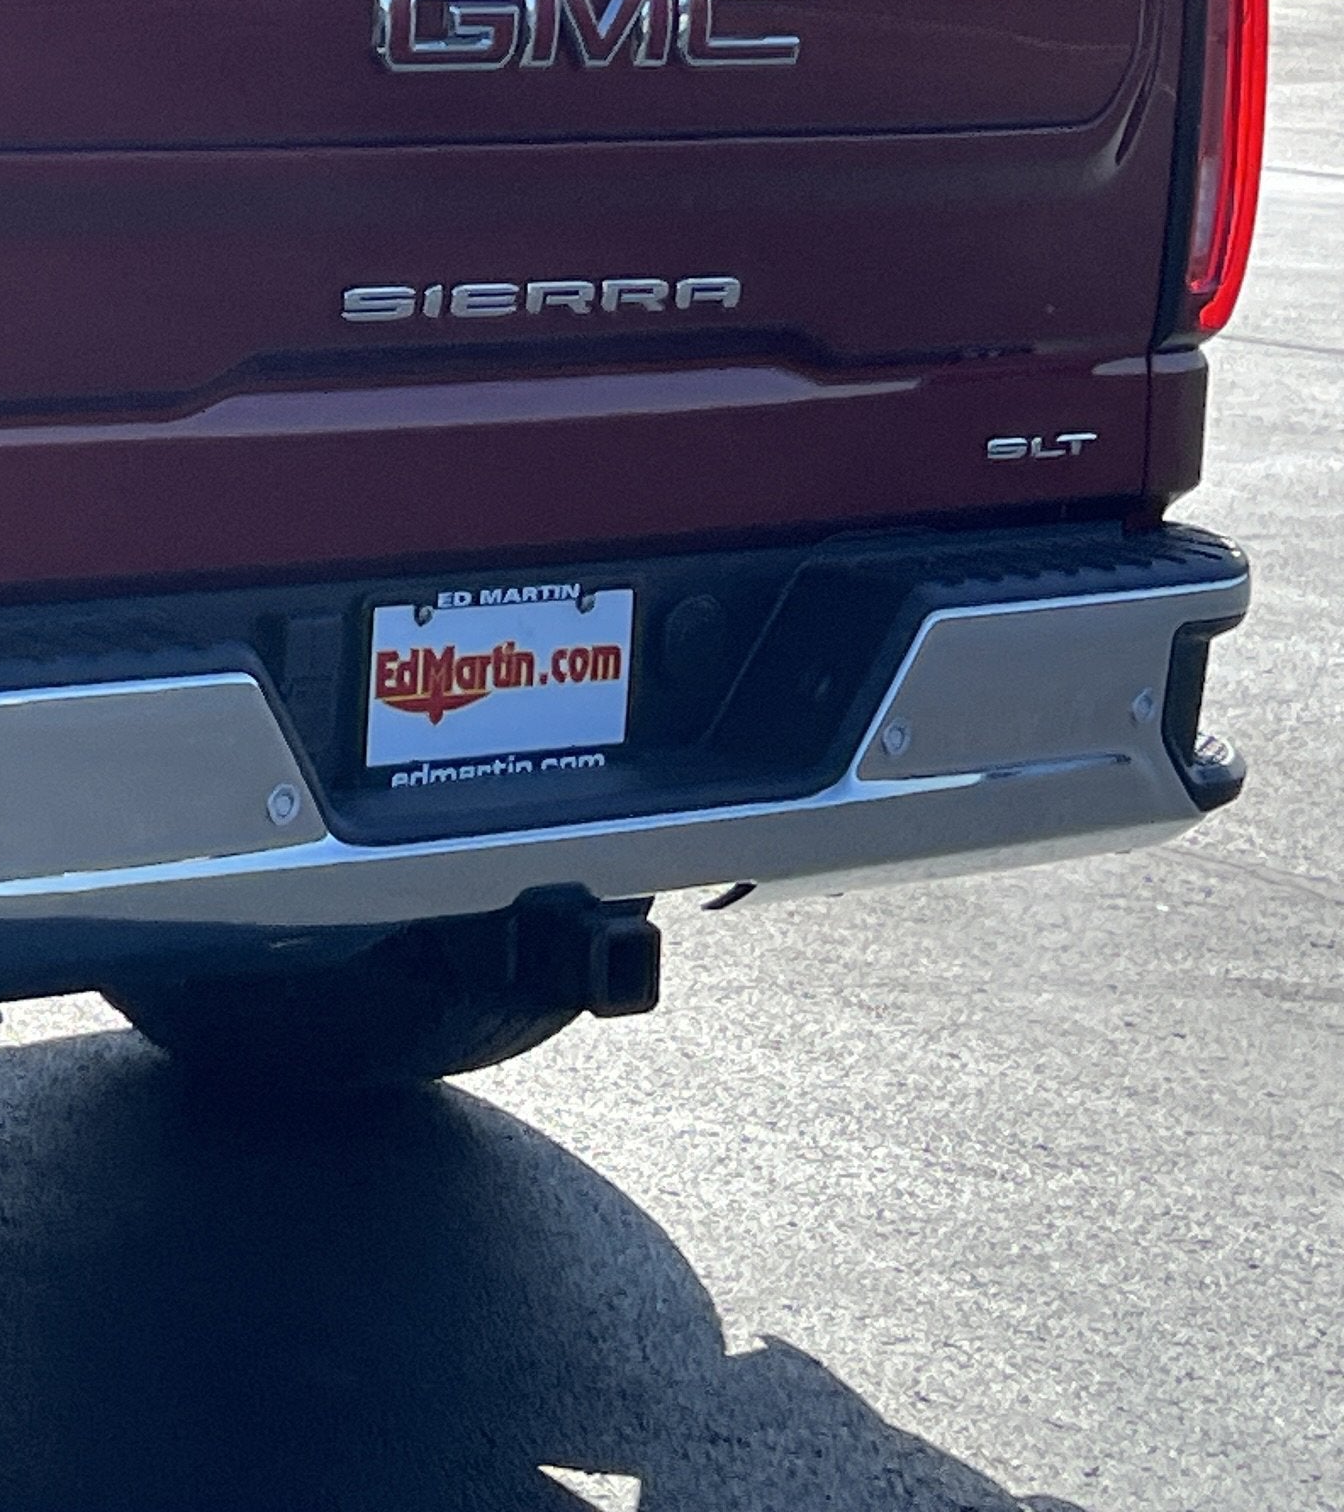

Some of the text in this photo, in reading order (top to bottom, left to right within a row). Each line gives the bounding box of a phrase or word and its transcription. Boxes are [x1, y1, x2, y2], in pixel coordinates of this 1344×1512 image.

[341, 277, 741, 322] SIERRA
[987, 433, 1097, 459] SLT
[438, 584, 580, 608] ED MARTIN
[374, 641, 621, 718] EdMartin.com
[391, 753, 605, 788] edmartincom
